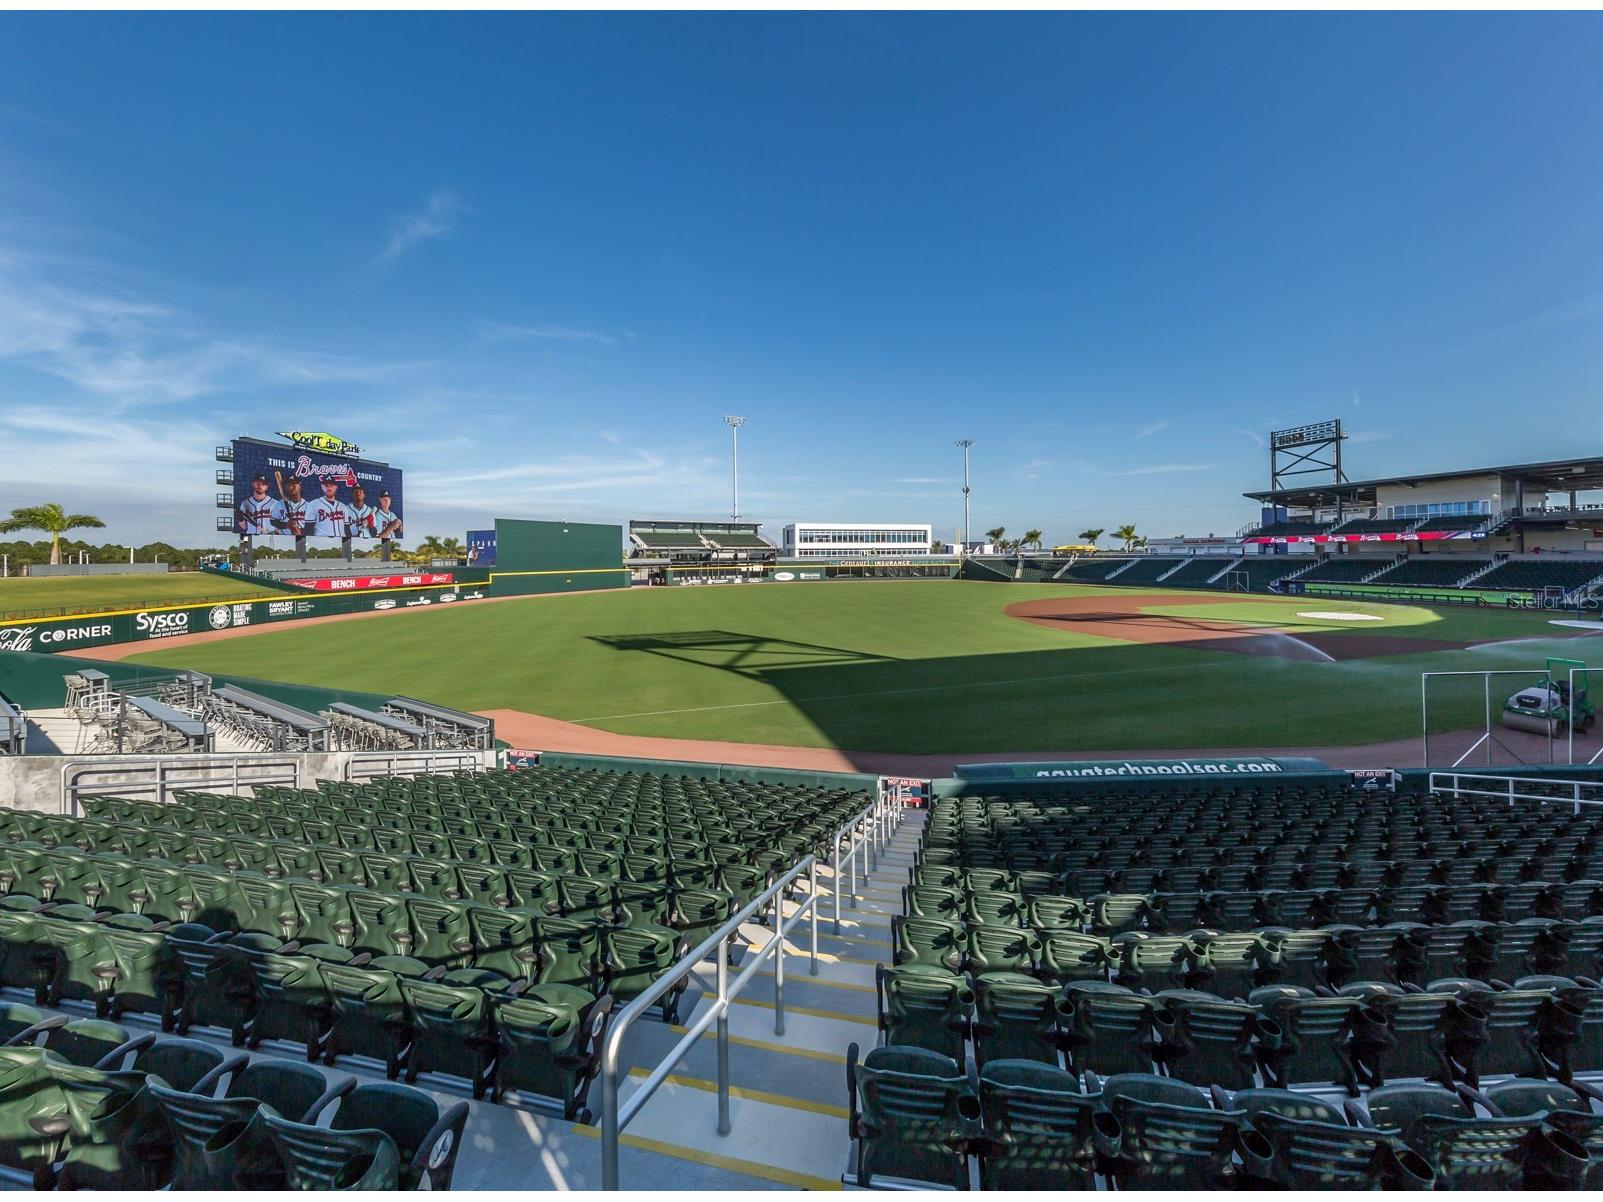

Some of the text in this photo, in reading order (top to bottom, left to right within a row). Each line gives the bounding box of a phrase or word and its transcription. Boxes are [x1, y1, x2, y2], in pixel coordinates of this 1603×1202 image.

[268, 455, 348, 478] THIS IS Braves
[357, 472, 382, 482] COUNTRY
[331, 580, 356, 589] BENCH
[403, 576, 421, 584] BENCH
[40, 625, 112, 643] CORNER
